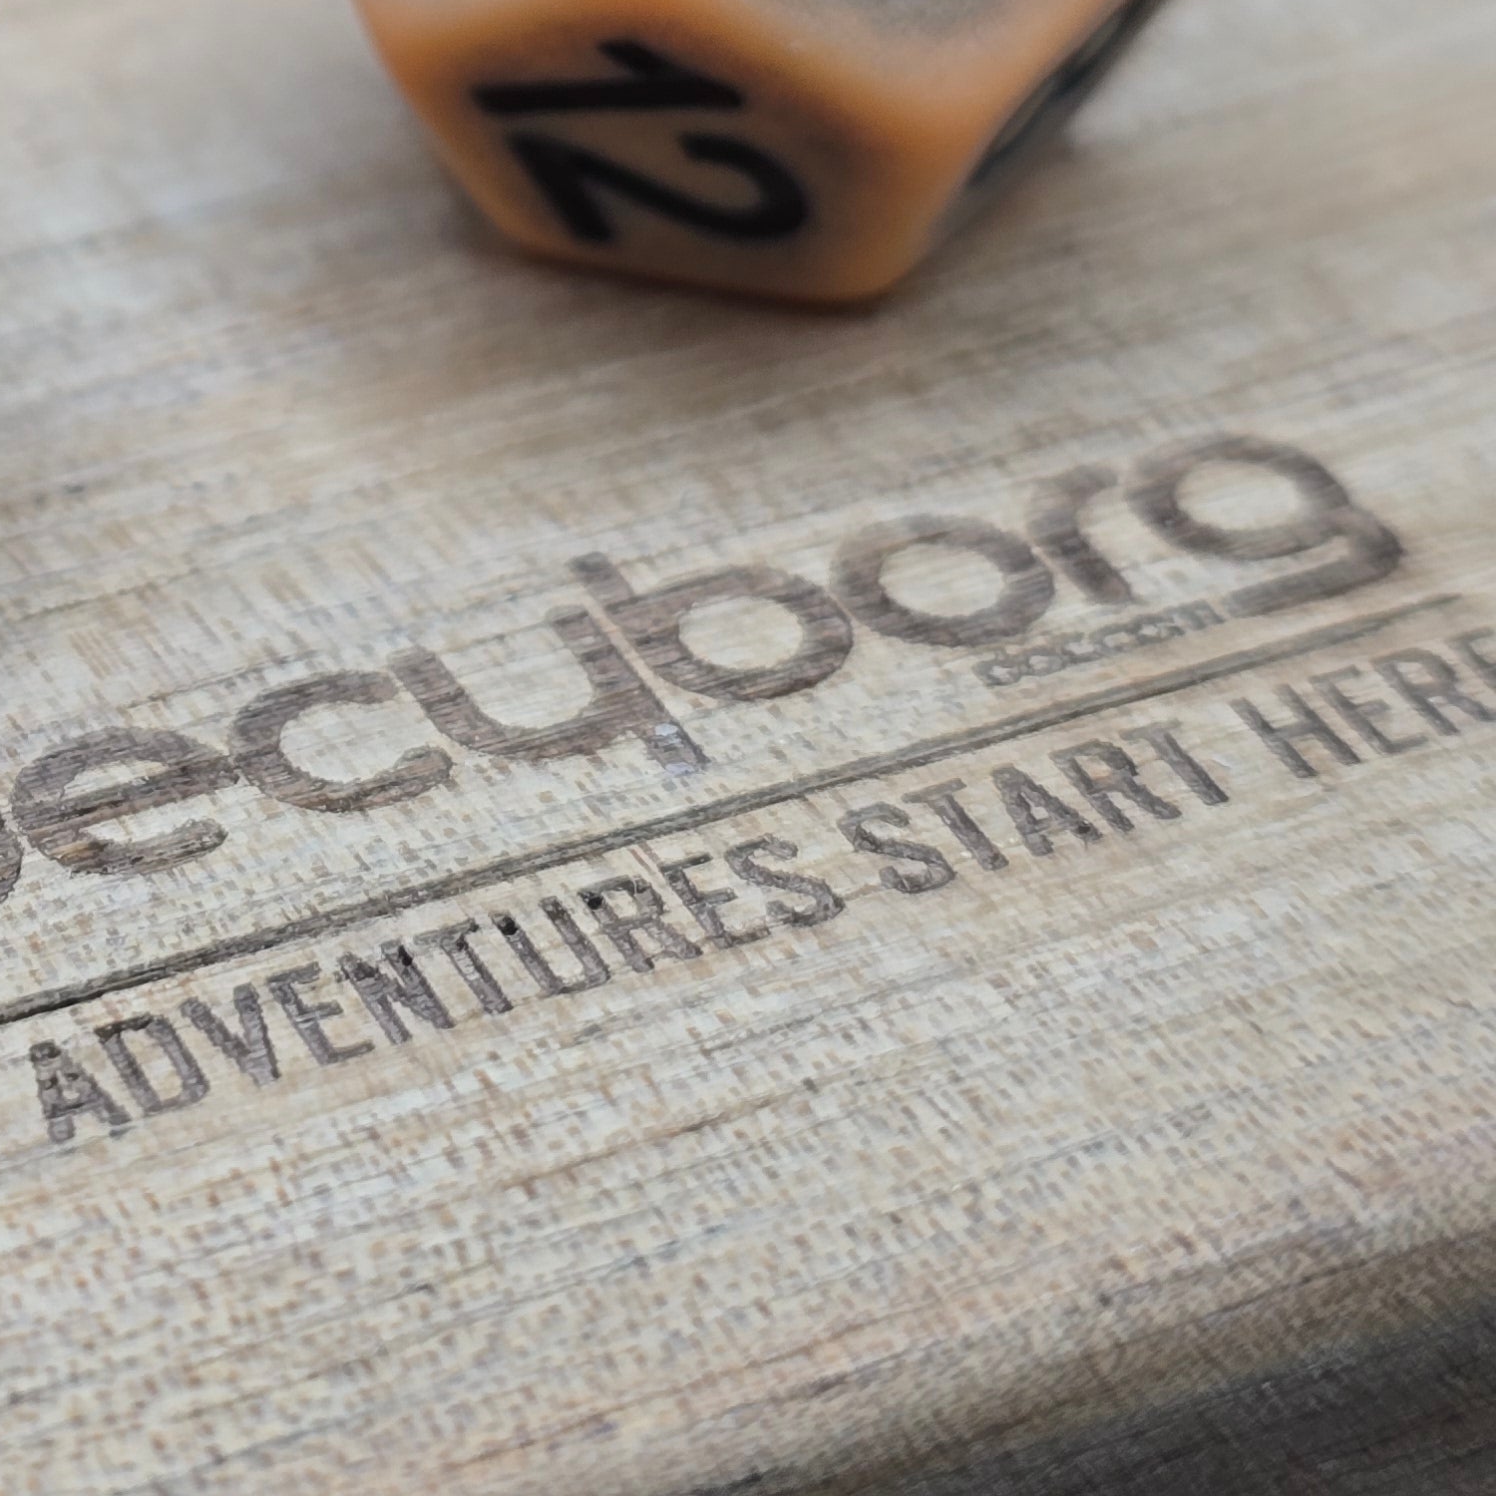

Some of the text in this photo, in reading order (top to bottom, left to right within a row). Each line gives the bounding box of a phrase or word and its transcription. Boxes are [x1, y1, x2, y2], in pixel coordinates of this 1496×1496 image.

[469, 39, 809, 246] 12
[26, 834, 844, 1141] ADVENTURES
[837, 720, 1230, 896] START
